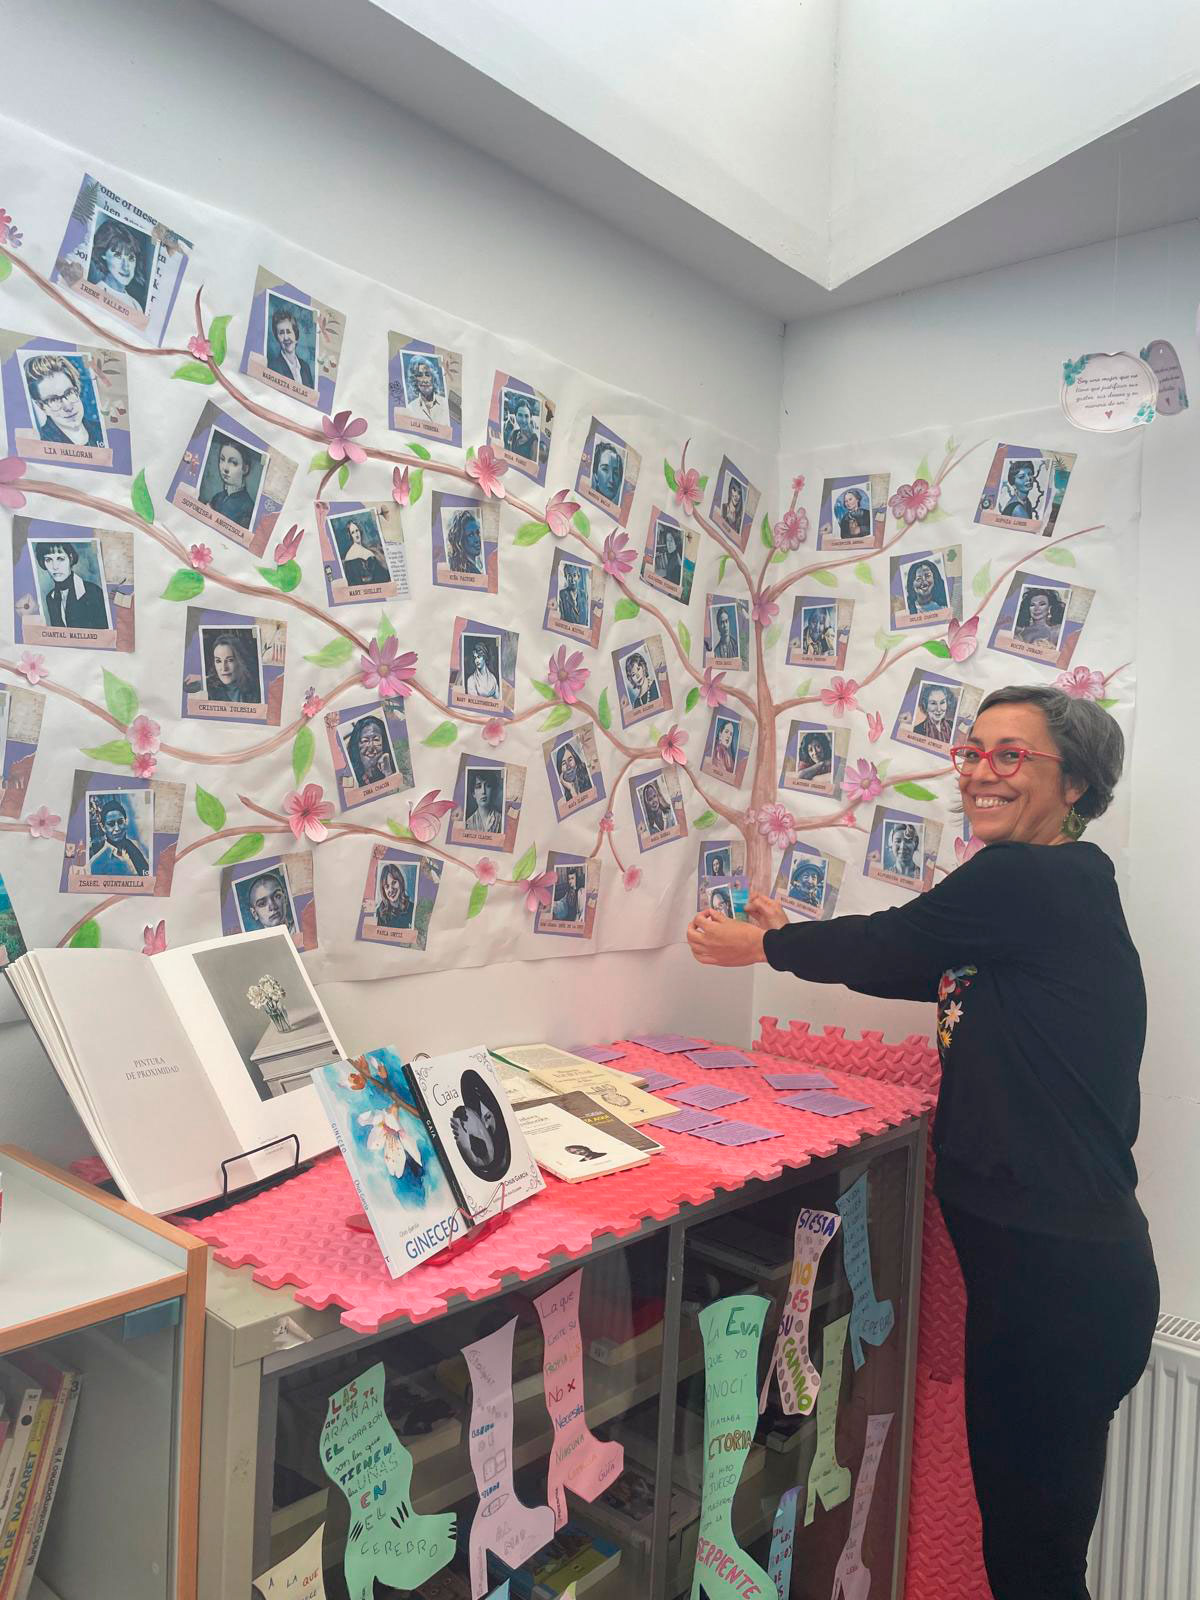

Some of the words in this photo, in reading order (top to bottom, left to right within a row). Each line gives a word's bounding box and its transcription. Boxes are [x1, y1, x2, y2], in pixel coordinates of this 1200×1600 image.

[80, 283, 100, 300] IRENE
[103, 297, 130, 317] VALLEJO
[292, 385, 309, 398] SALAS
[60, 449, 93, 459] HALLORAN
[42, 631, 66, 639] CHANTAL
[199, 704, 227, 712] CRISTINA
[103, 880, 144, 888] QUINTANILLA
[133, 1056, 166, 1068] PINTURA
[126, 1071, 137, 1081] DE
[137, 1064, 180, 1079] PROXIMIDAD
[433, 1083, 459, 1107] Gaia
[331, 1121, 348, 1154] GINECEO
[426, 1119, 437, 1139] GAIA
[406, 1215, 459, 1259] GINECEO
[325, 1443, 344, 1463] EL
[708, 1430, 753, 1461] CTORIA
[10, 1450, 38, 1522] NAZARET
[360, 1480, 387, 1509] EN
[364, 1507, 387, 1531] EL
[3, 1528, 18, 1550] DE
[360, 1539, 438, 1558] CEREBRO
[302, 1567, 320, 1587] QUE
